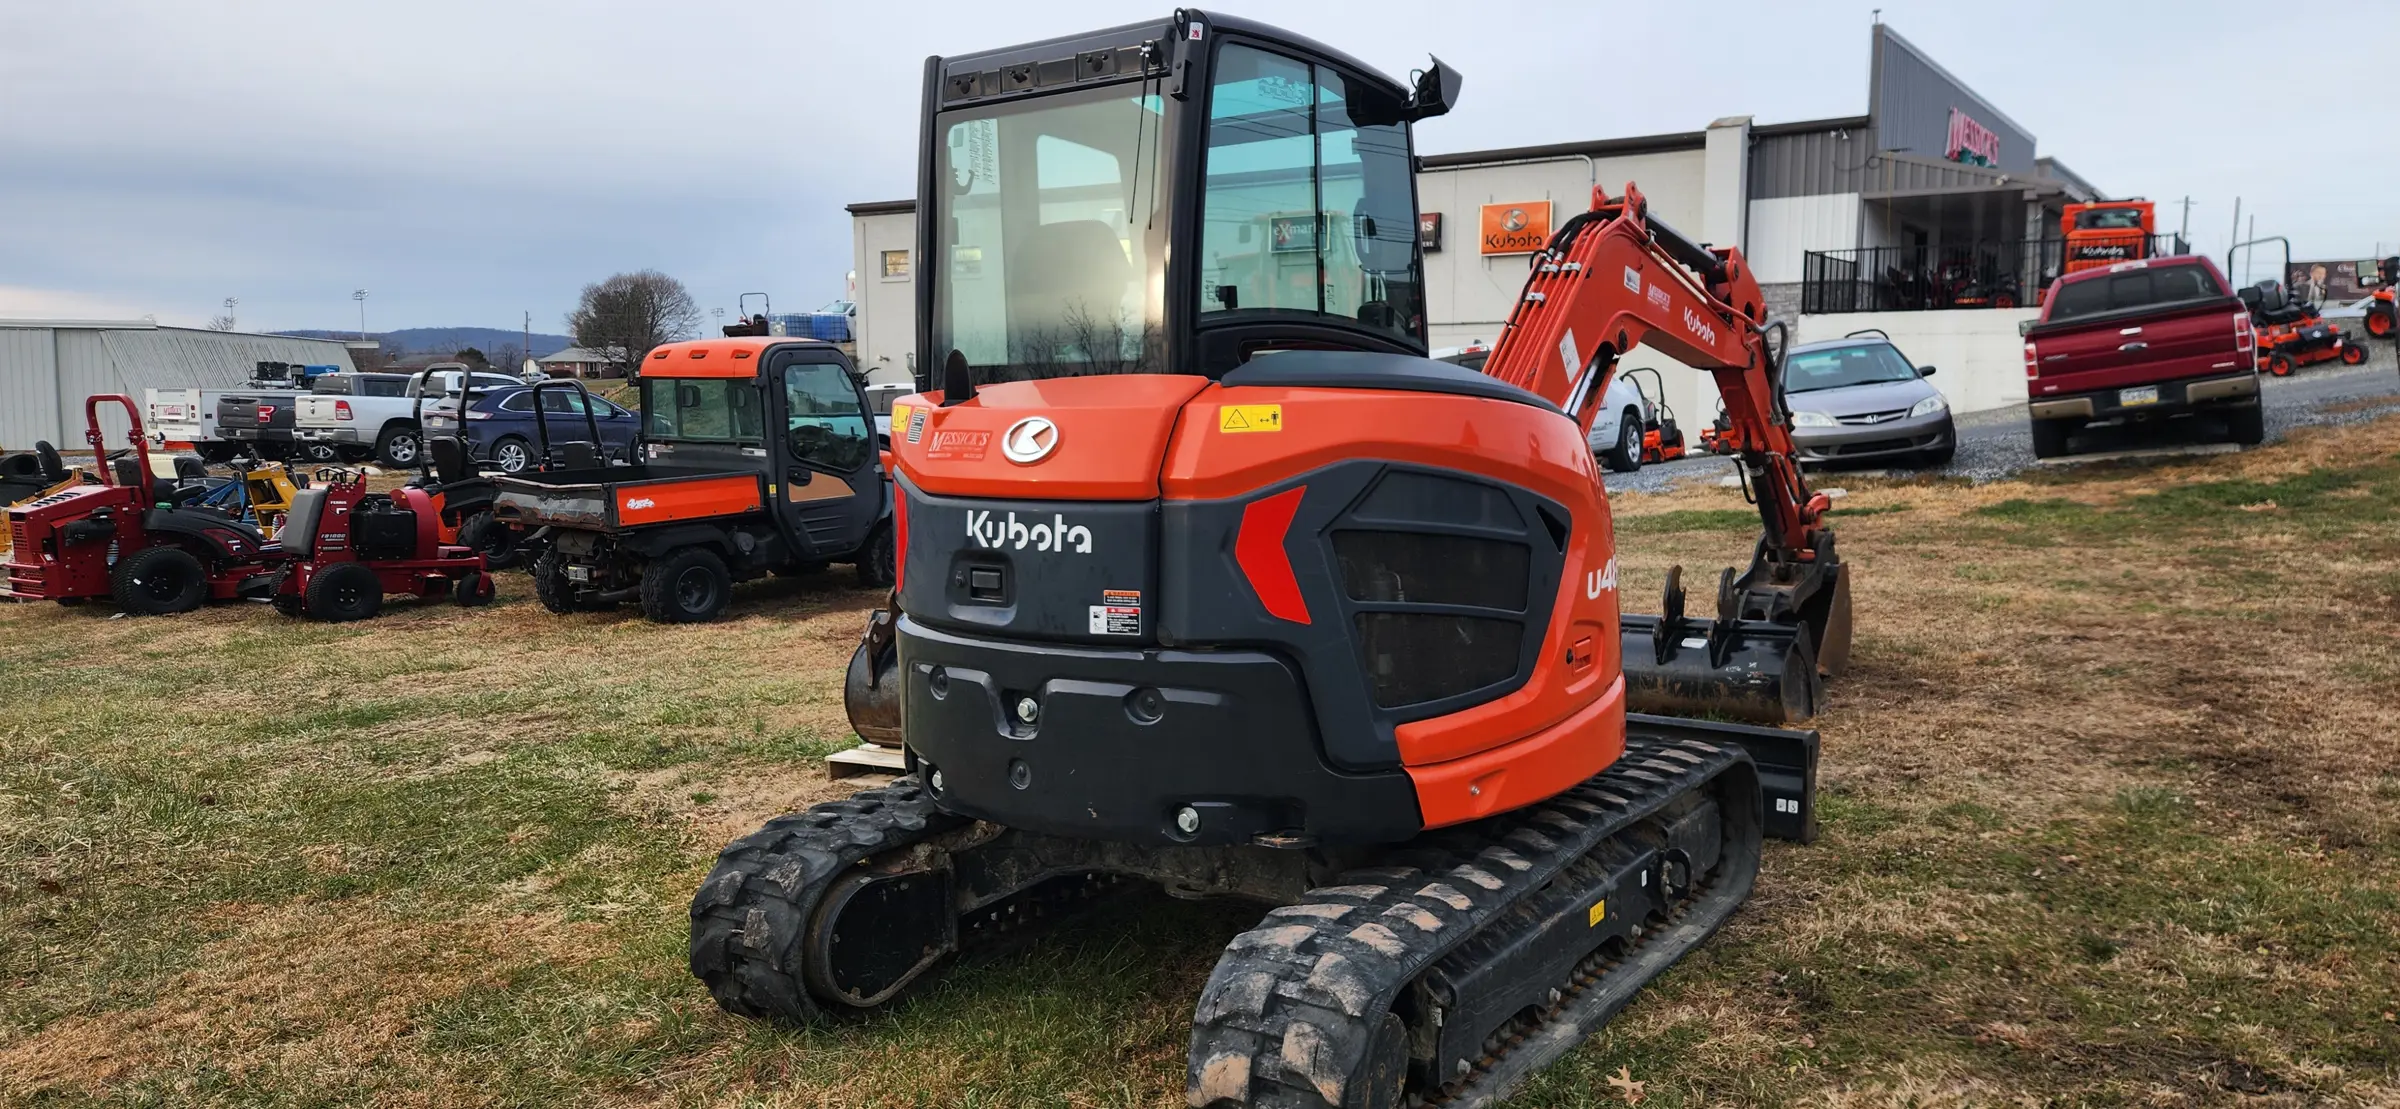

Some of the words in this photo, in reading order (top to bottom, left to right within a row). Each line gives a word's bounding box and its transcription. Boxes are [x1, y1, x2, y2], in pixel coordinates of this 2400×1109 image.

[1486, 232, 1543, 249] Kubota
[1683, 306, 1716, 347] Kubota
[929, 431, 990, 452] MESSICK'S
[966, 509, 1093, 554] Kubota
